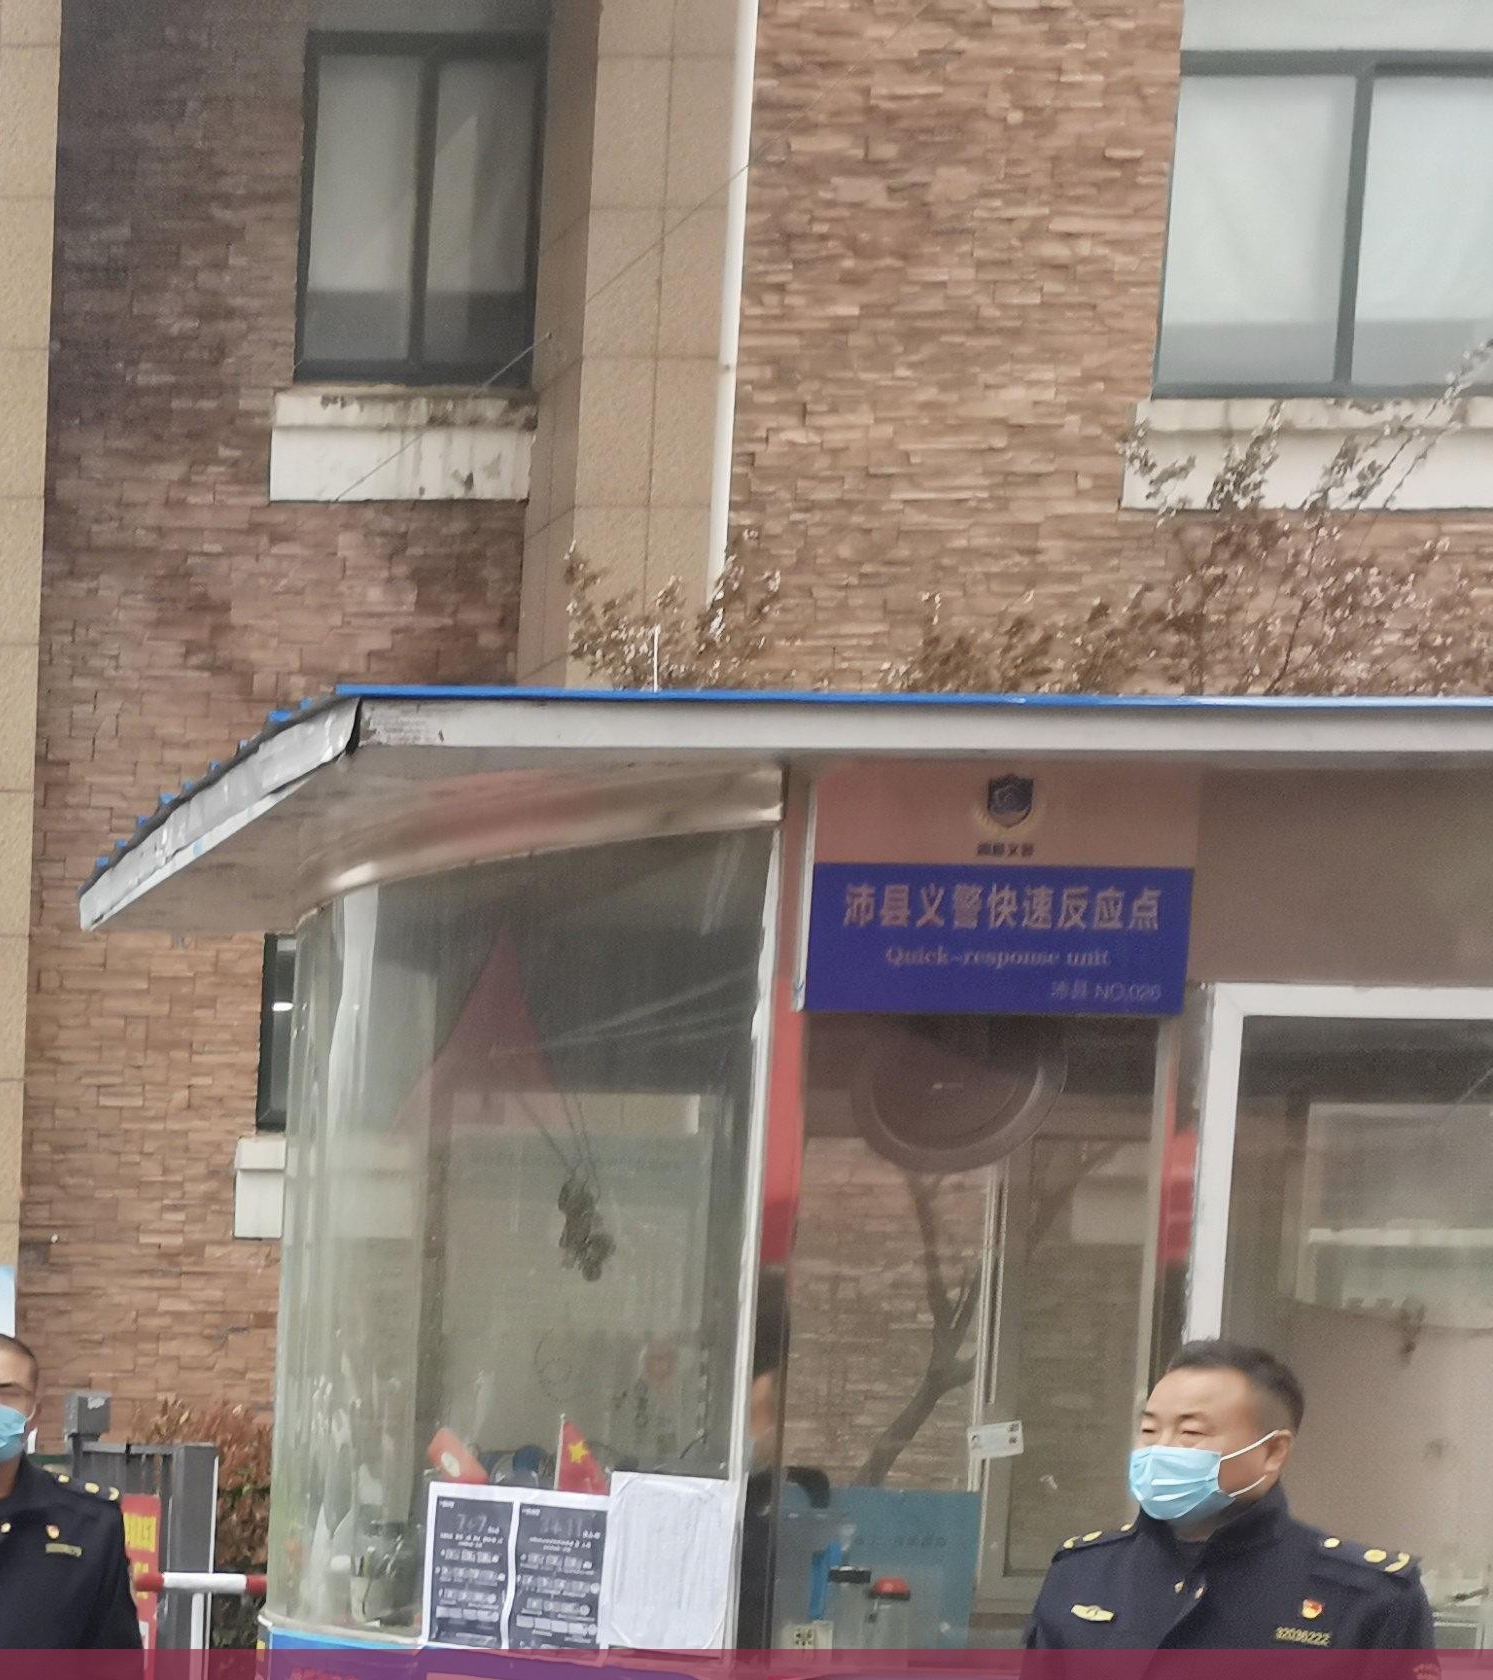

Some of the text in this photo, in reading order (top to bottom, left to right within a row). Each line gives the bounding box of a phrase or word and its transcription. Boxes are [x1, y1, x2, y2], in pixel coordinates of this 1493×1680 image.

[843, 883, 1161, 931] 沛县义警快速反应点
